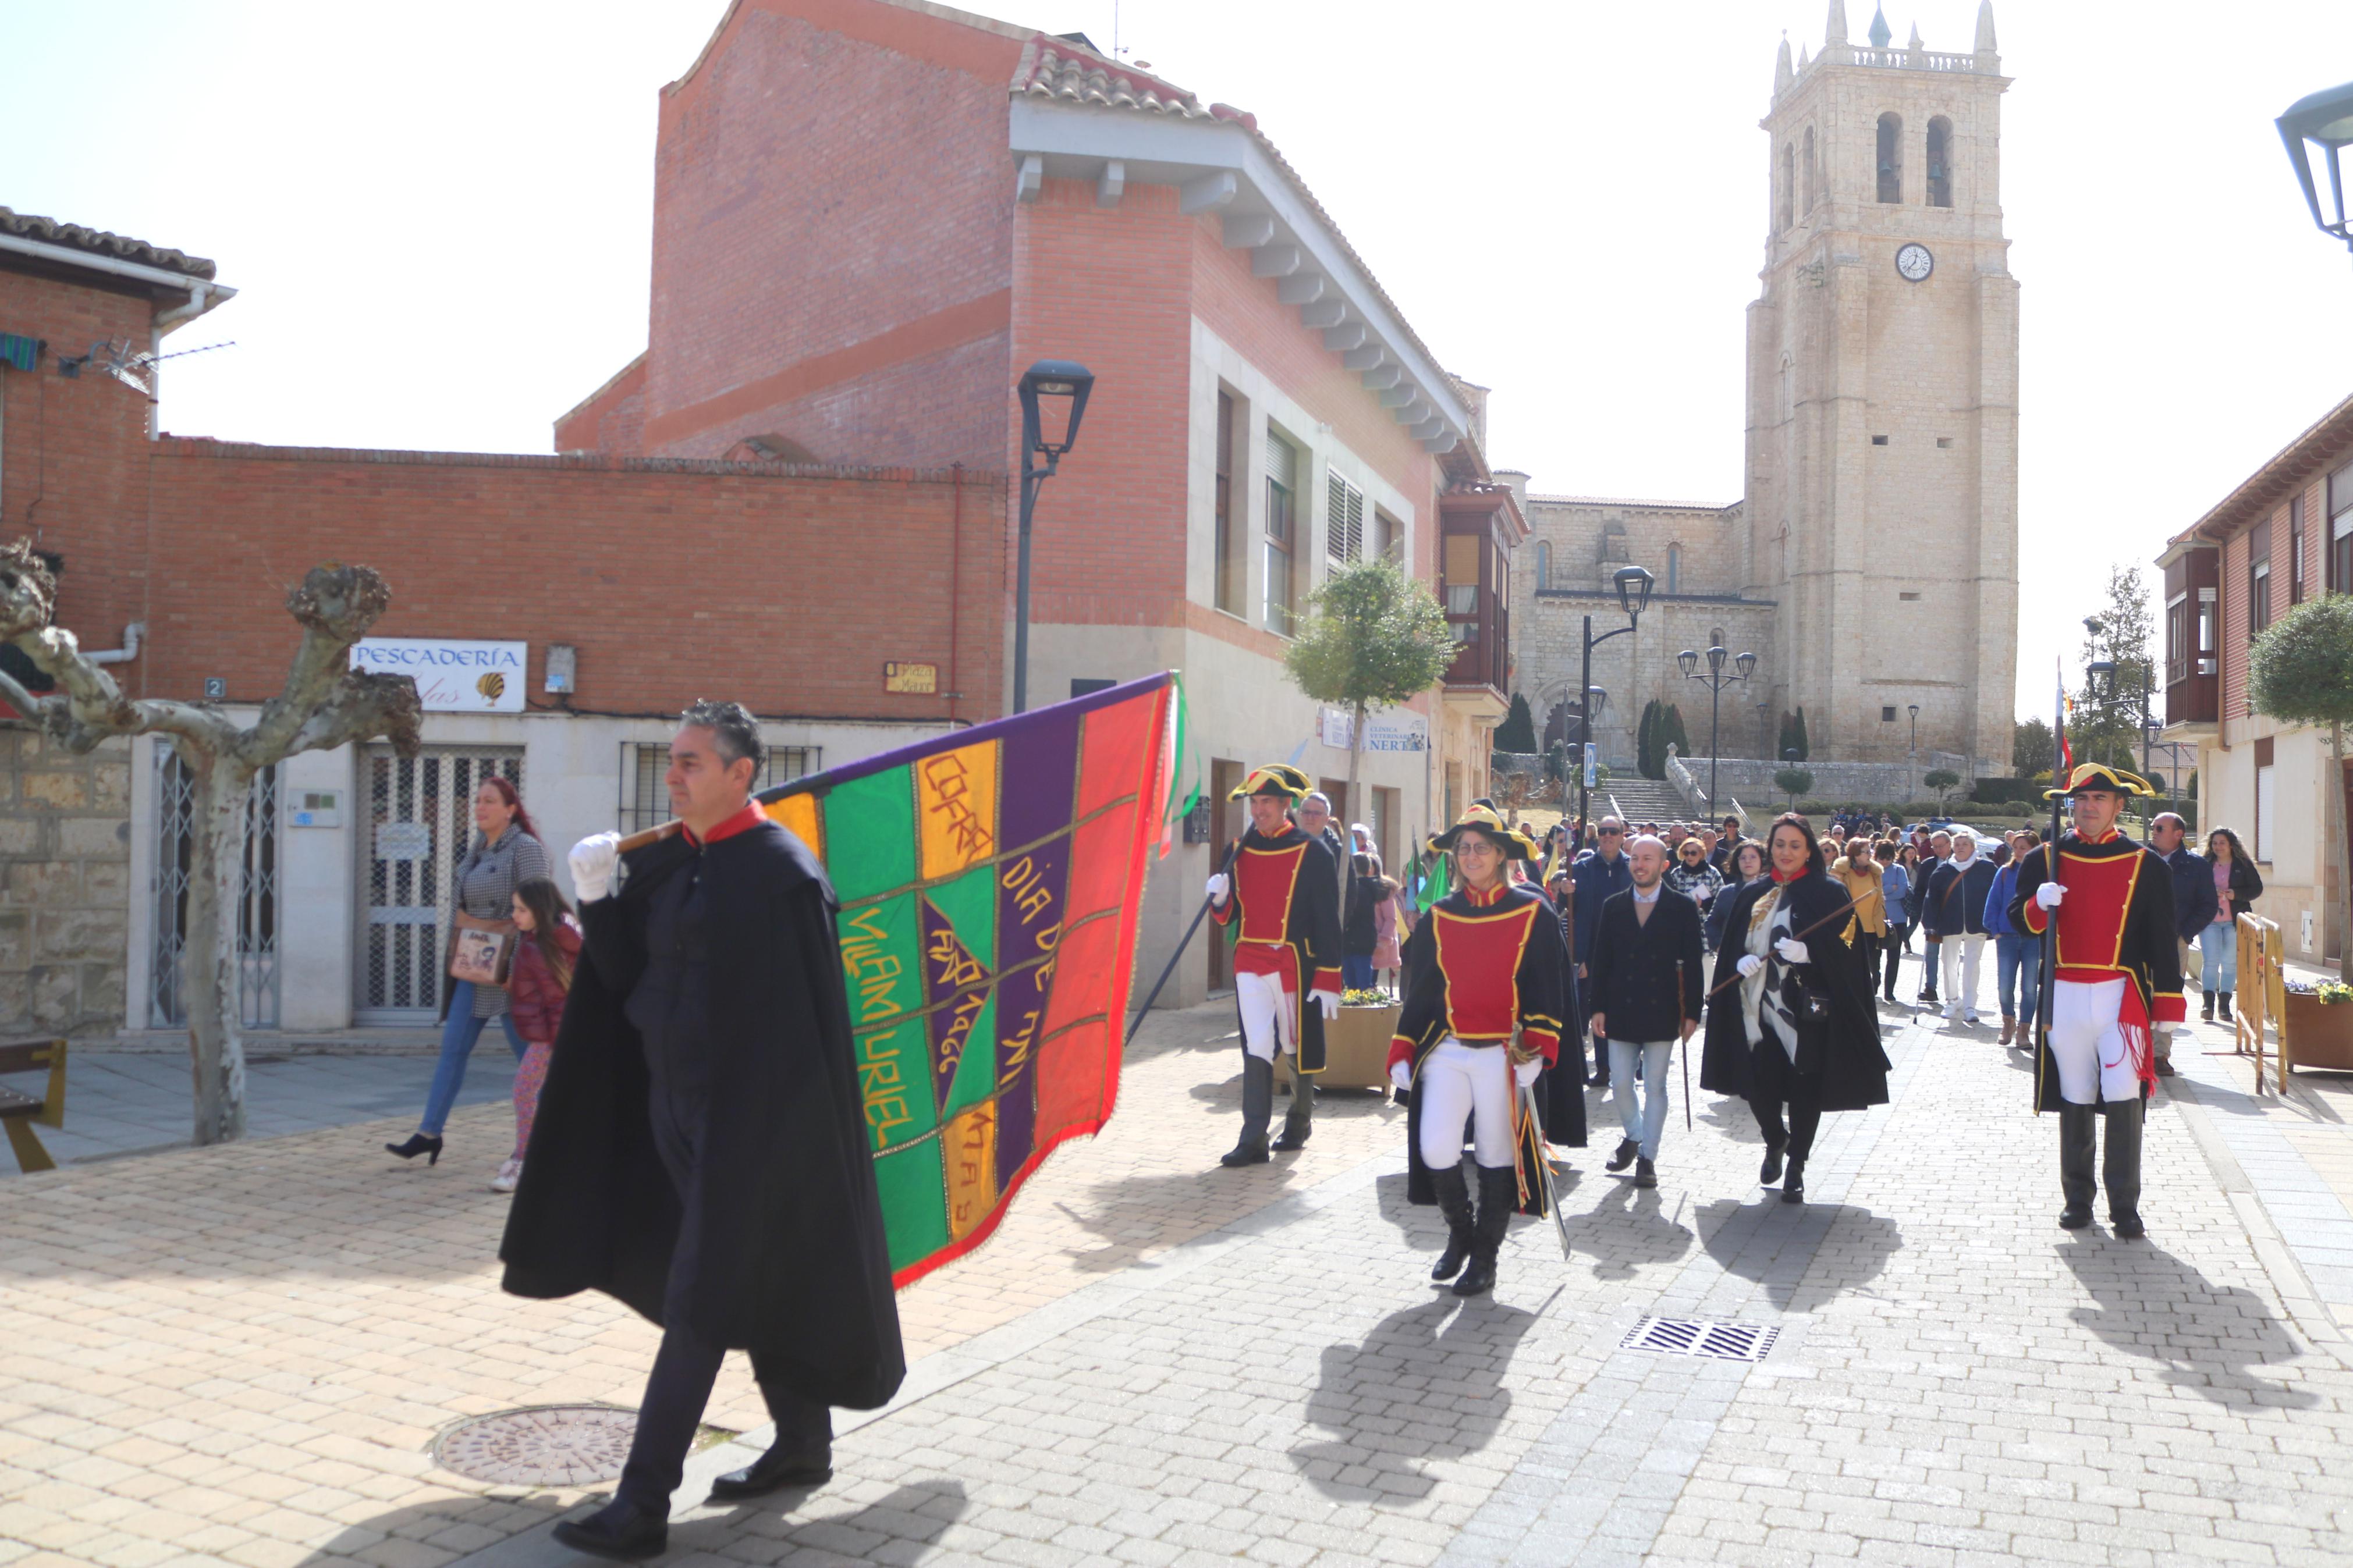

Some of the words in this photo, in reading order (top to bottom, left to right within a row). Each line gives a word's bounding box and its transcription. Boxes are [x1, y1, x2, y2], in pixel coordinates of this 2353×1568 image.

[356, 646, 519, 667] PESCADERÍA
[210, 681, 219, 695] 2
[1587, 748, 1593, 781] P
